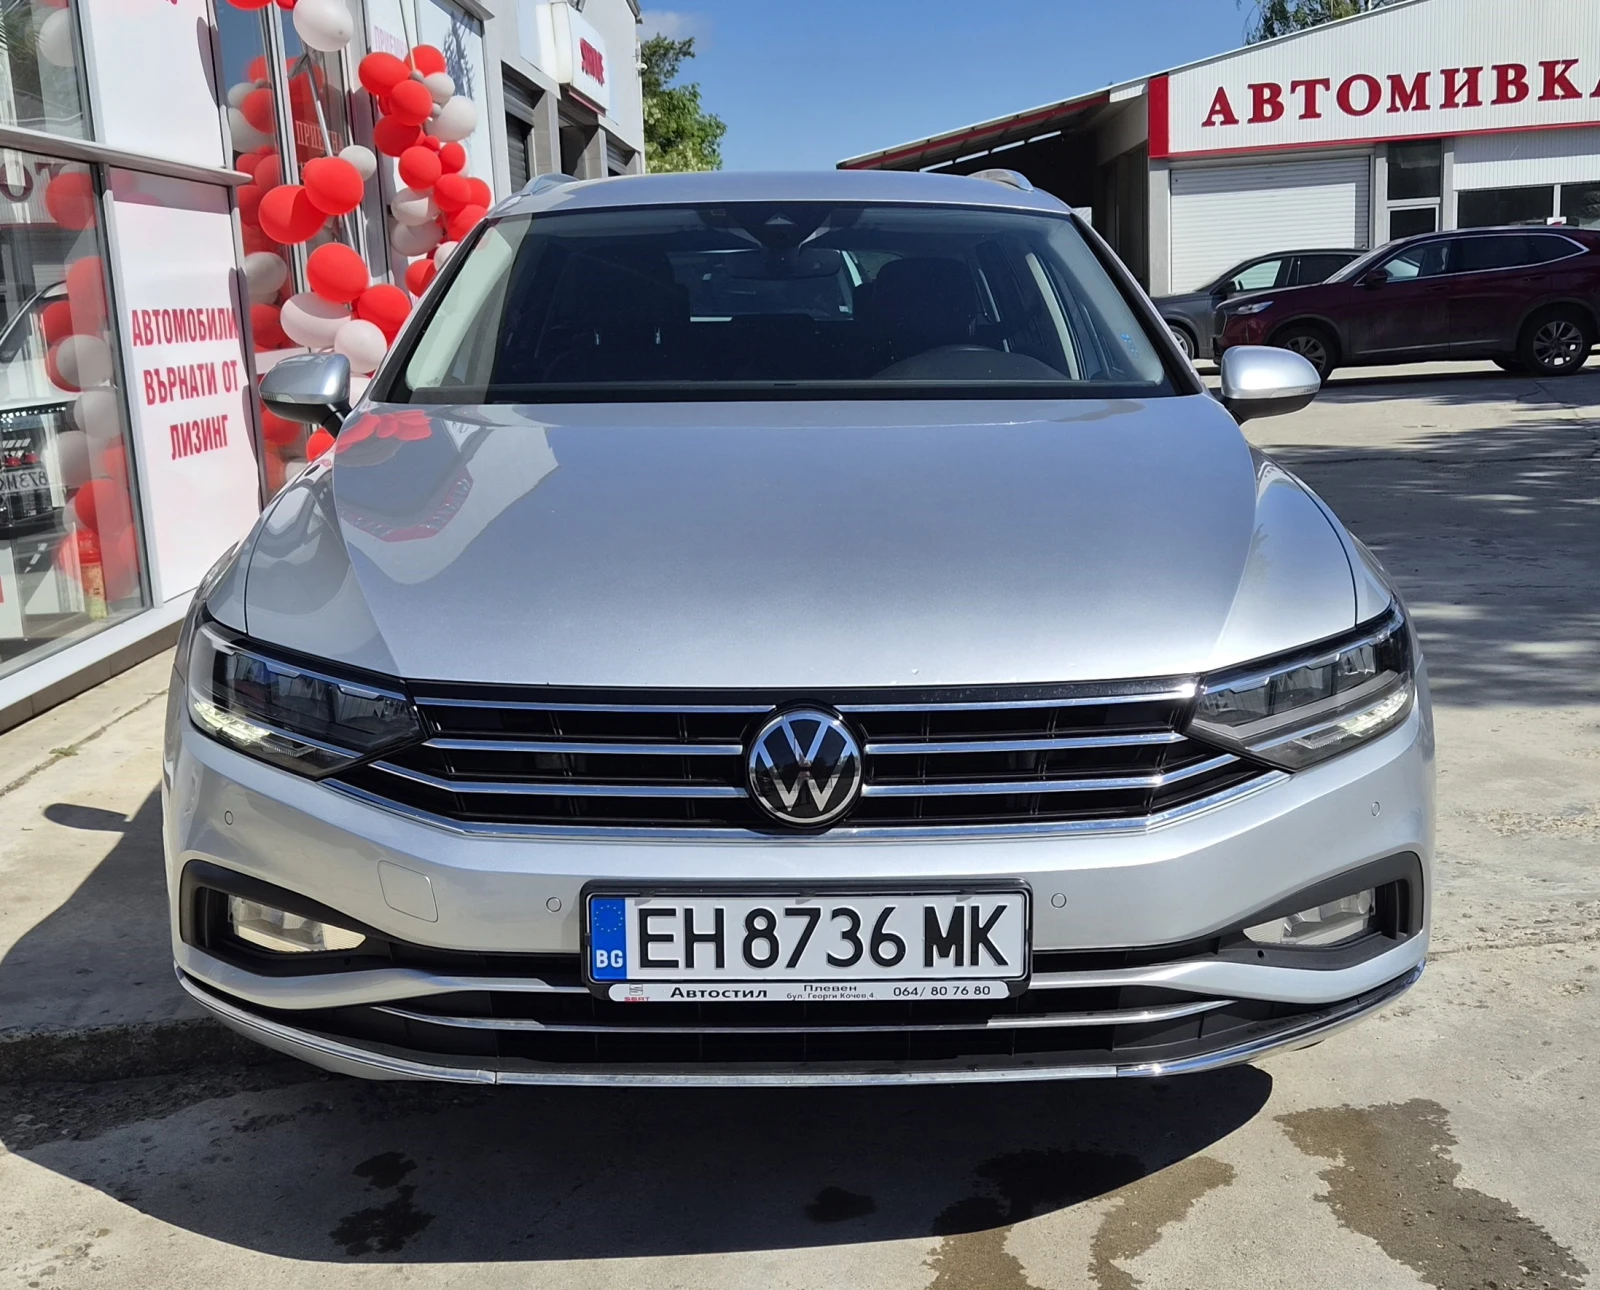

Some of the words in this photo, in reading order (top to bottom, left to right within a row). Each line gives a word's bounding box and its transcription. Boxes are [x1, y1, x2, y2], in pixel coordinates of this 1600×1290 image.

[132, 308, 239, 346] АВТОМОБИЛИ
[143, 362, 218, 406] ВЪРНАТИ
[222, 360, 238, 393] ОТ
[170, 414, 228, 460] ЛИЗИНГ
[638, 907, 725, 968] EH
[742, 906, 907, 968] 8736
[924, 905, 1009, 967] MK
[596, 950, 623, 968] BG
[670, 987, 767, 999] Автостил
[803, 984, 857, 992] Плевен
[807, 993, 838, 1001] Георги
[893, 986, 926, 997] 064/
[931, 986, 948, 996] 80
[952, 986, 969, 996] 76
[973, 985, 991, 996] 80
